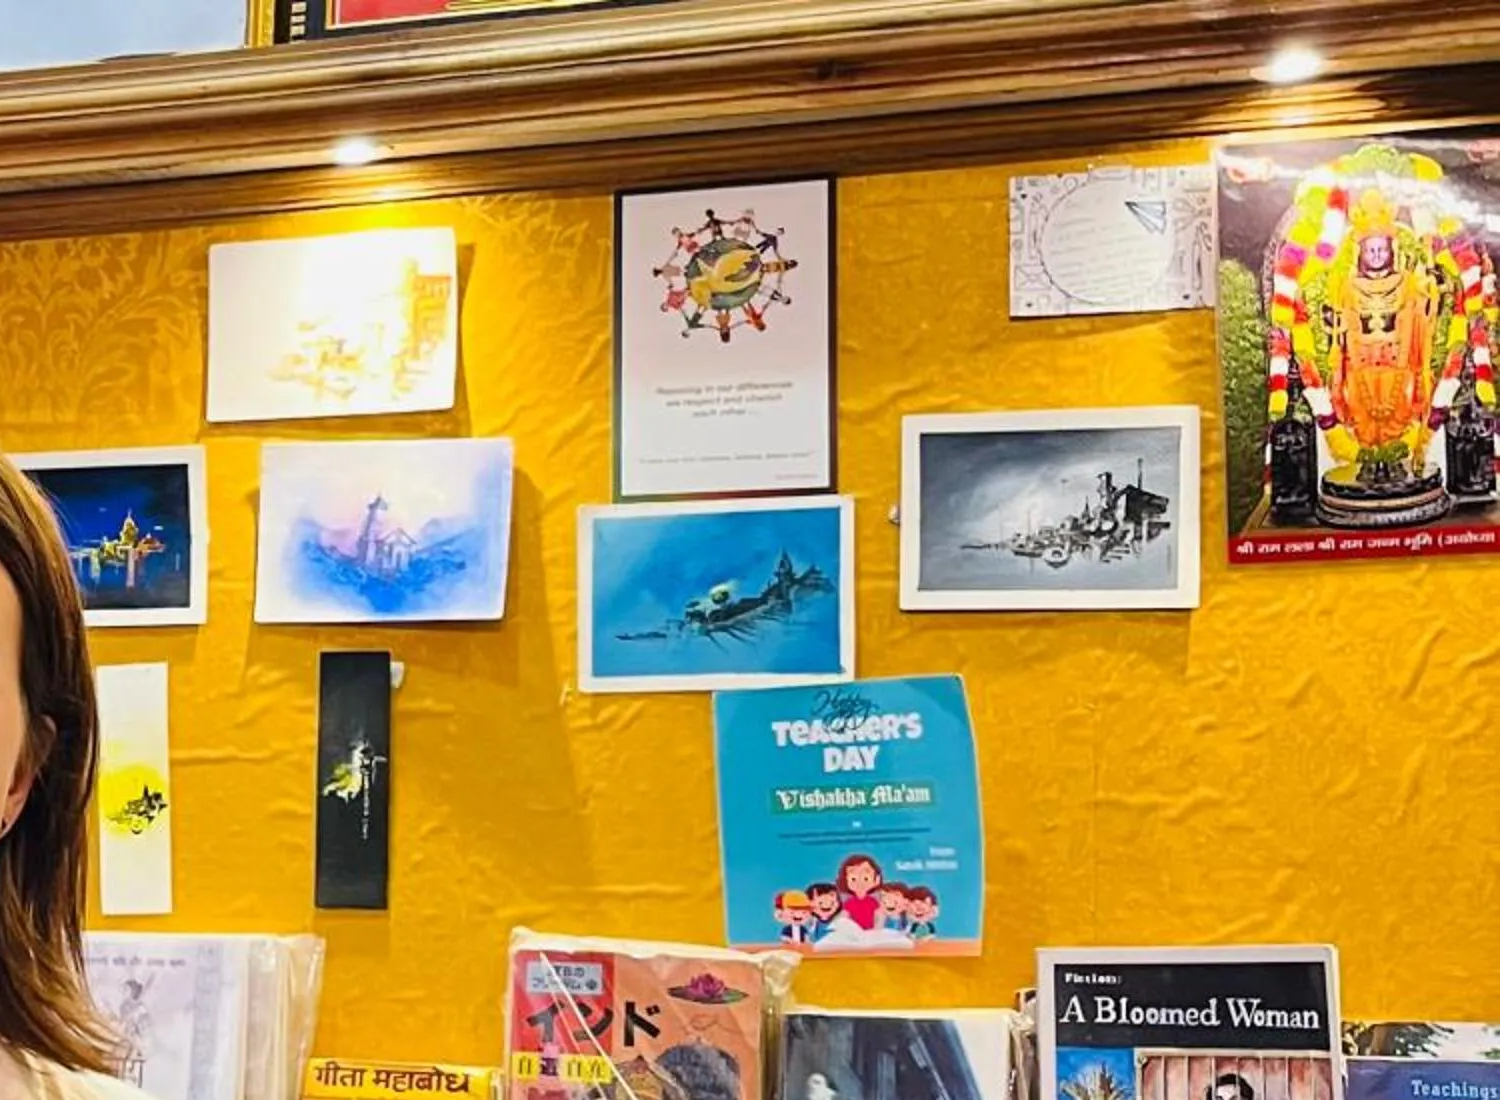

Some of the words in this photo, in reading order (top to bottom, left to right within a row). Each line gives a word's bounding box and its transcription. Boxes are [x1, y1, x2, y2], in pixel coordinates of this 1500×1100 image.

[823, 744, 881, 773] DAY
[775, 786, 867, 811] Vishakha
[871, 783, 931, 807] Ma'am
[526, 1000, 661, 1048] インド
[1058, 993, 1086, 1023] A
[1093, 996, 1221, 1027] Bloomed
[1225, 996, 1321, 1030] Woman
[314, 1060, 367, 1088] गीता
[372, 1065, 471, 1094] महाबोध
